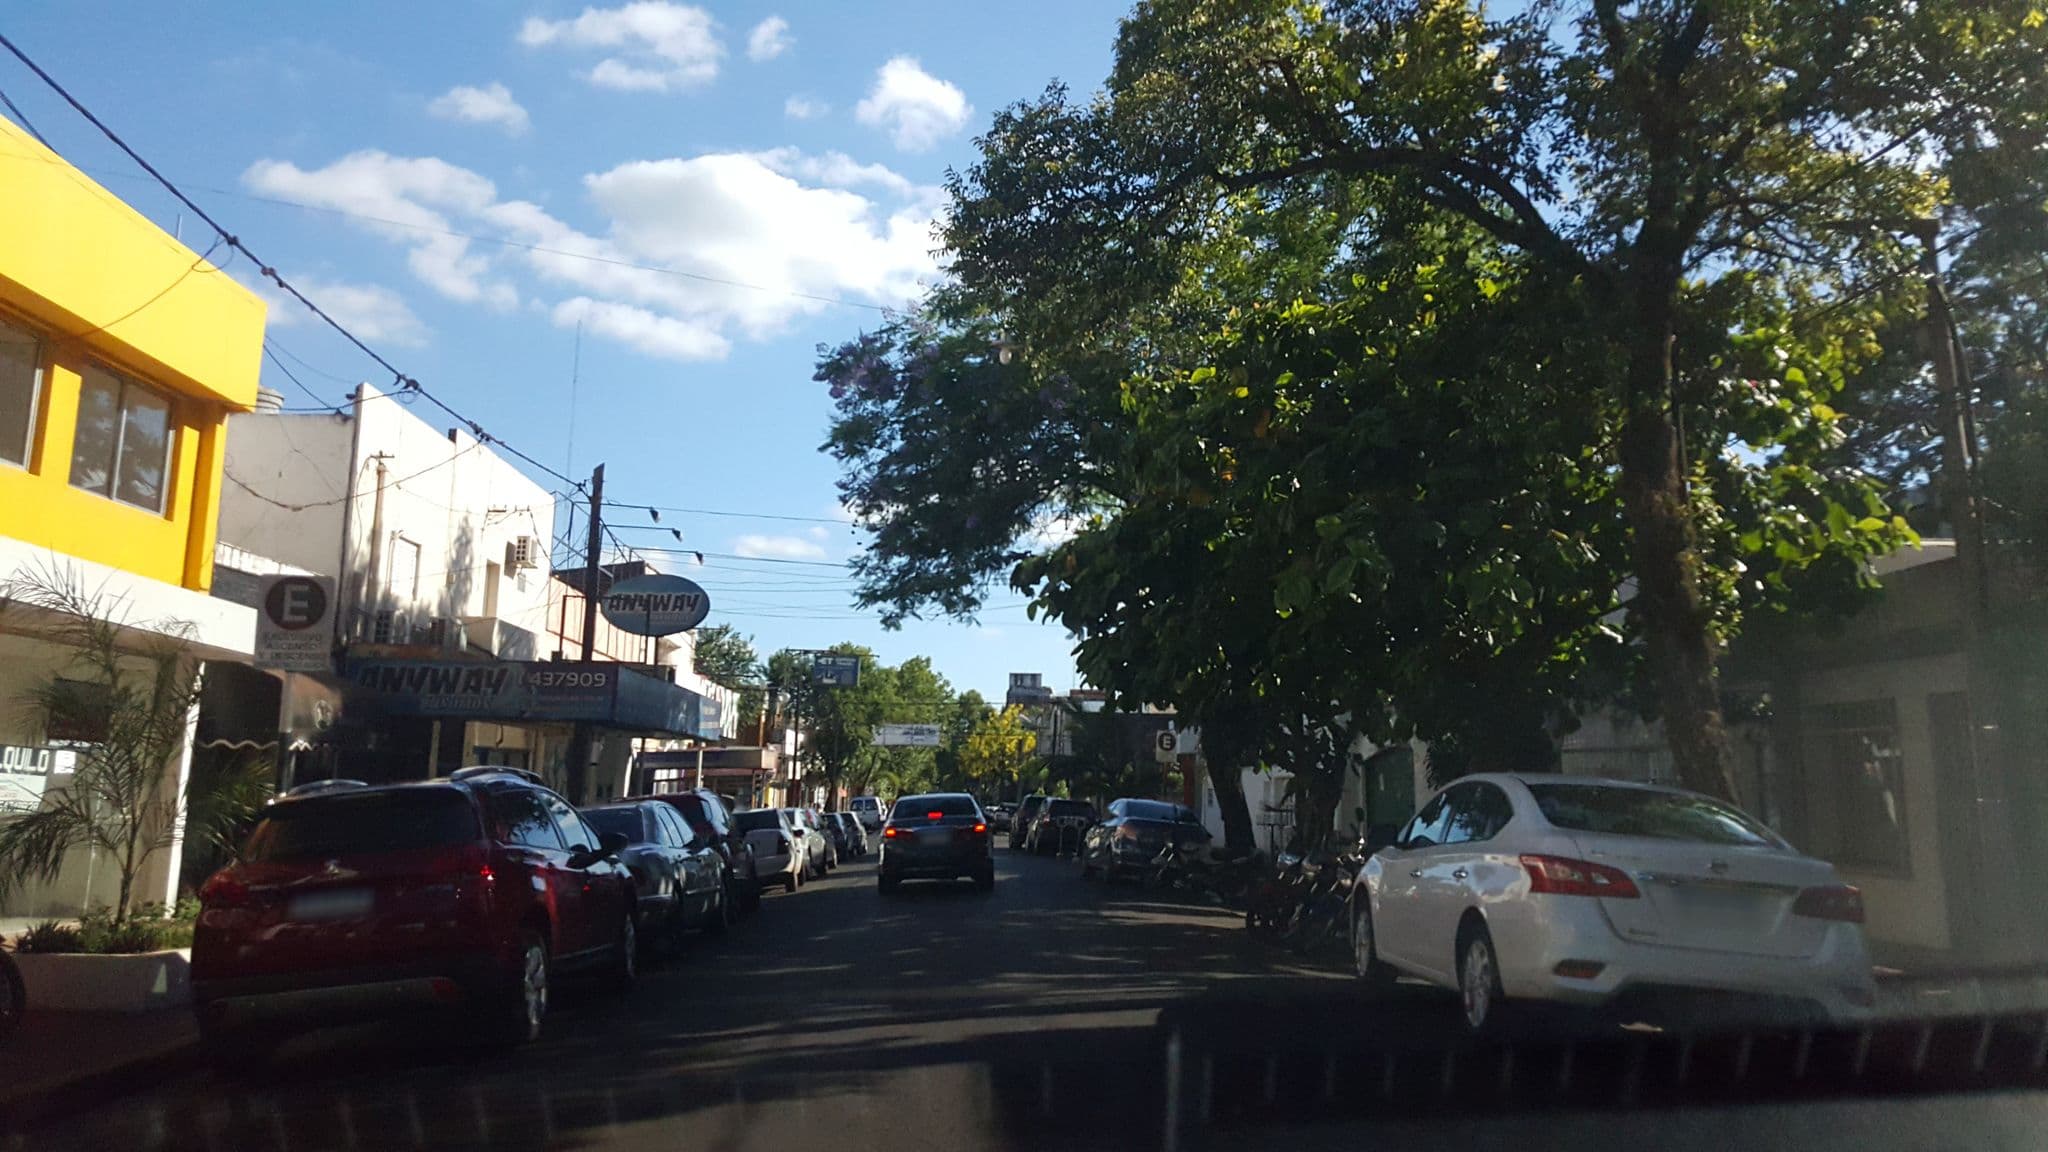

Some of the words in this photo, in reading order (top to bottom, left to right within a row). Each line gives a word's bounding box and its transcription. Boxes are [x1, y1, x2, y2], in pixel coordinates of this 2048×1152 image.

[283, 584, 309, 620] E
[608, 592, 702, 613] ANYWAY
[358, 664, 509, 695] ANYWAY
[529, 673, 606, 687] 437909
[1163, 735, 1172, 749] E
[0, 747, 49, 773] QUILO
